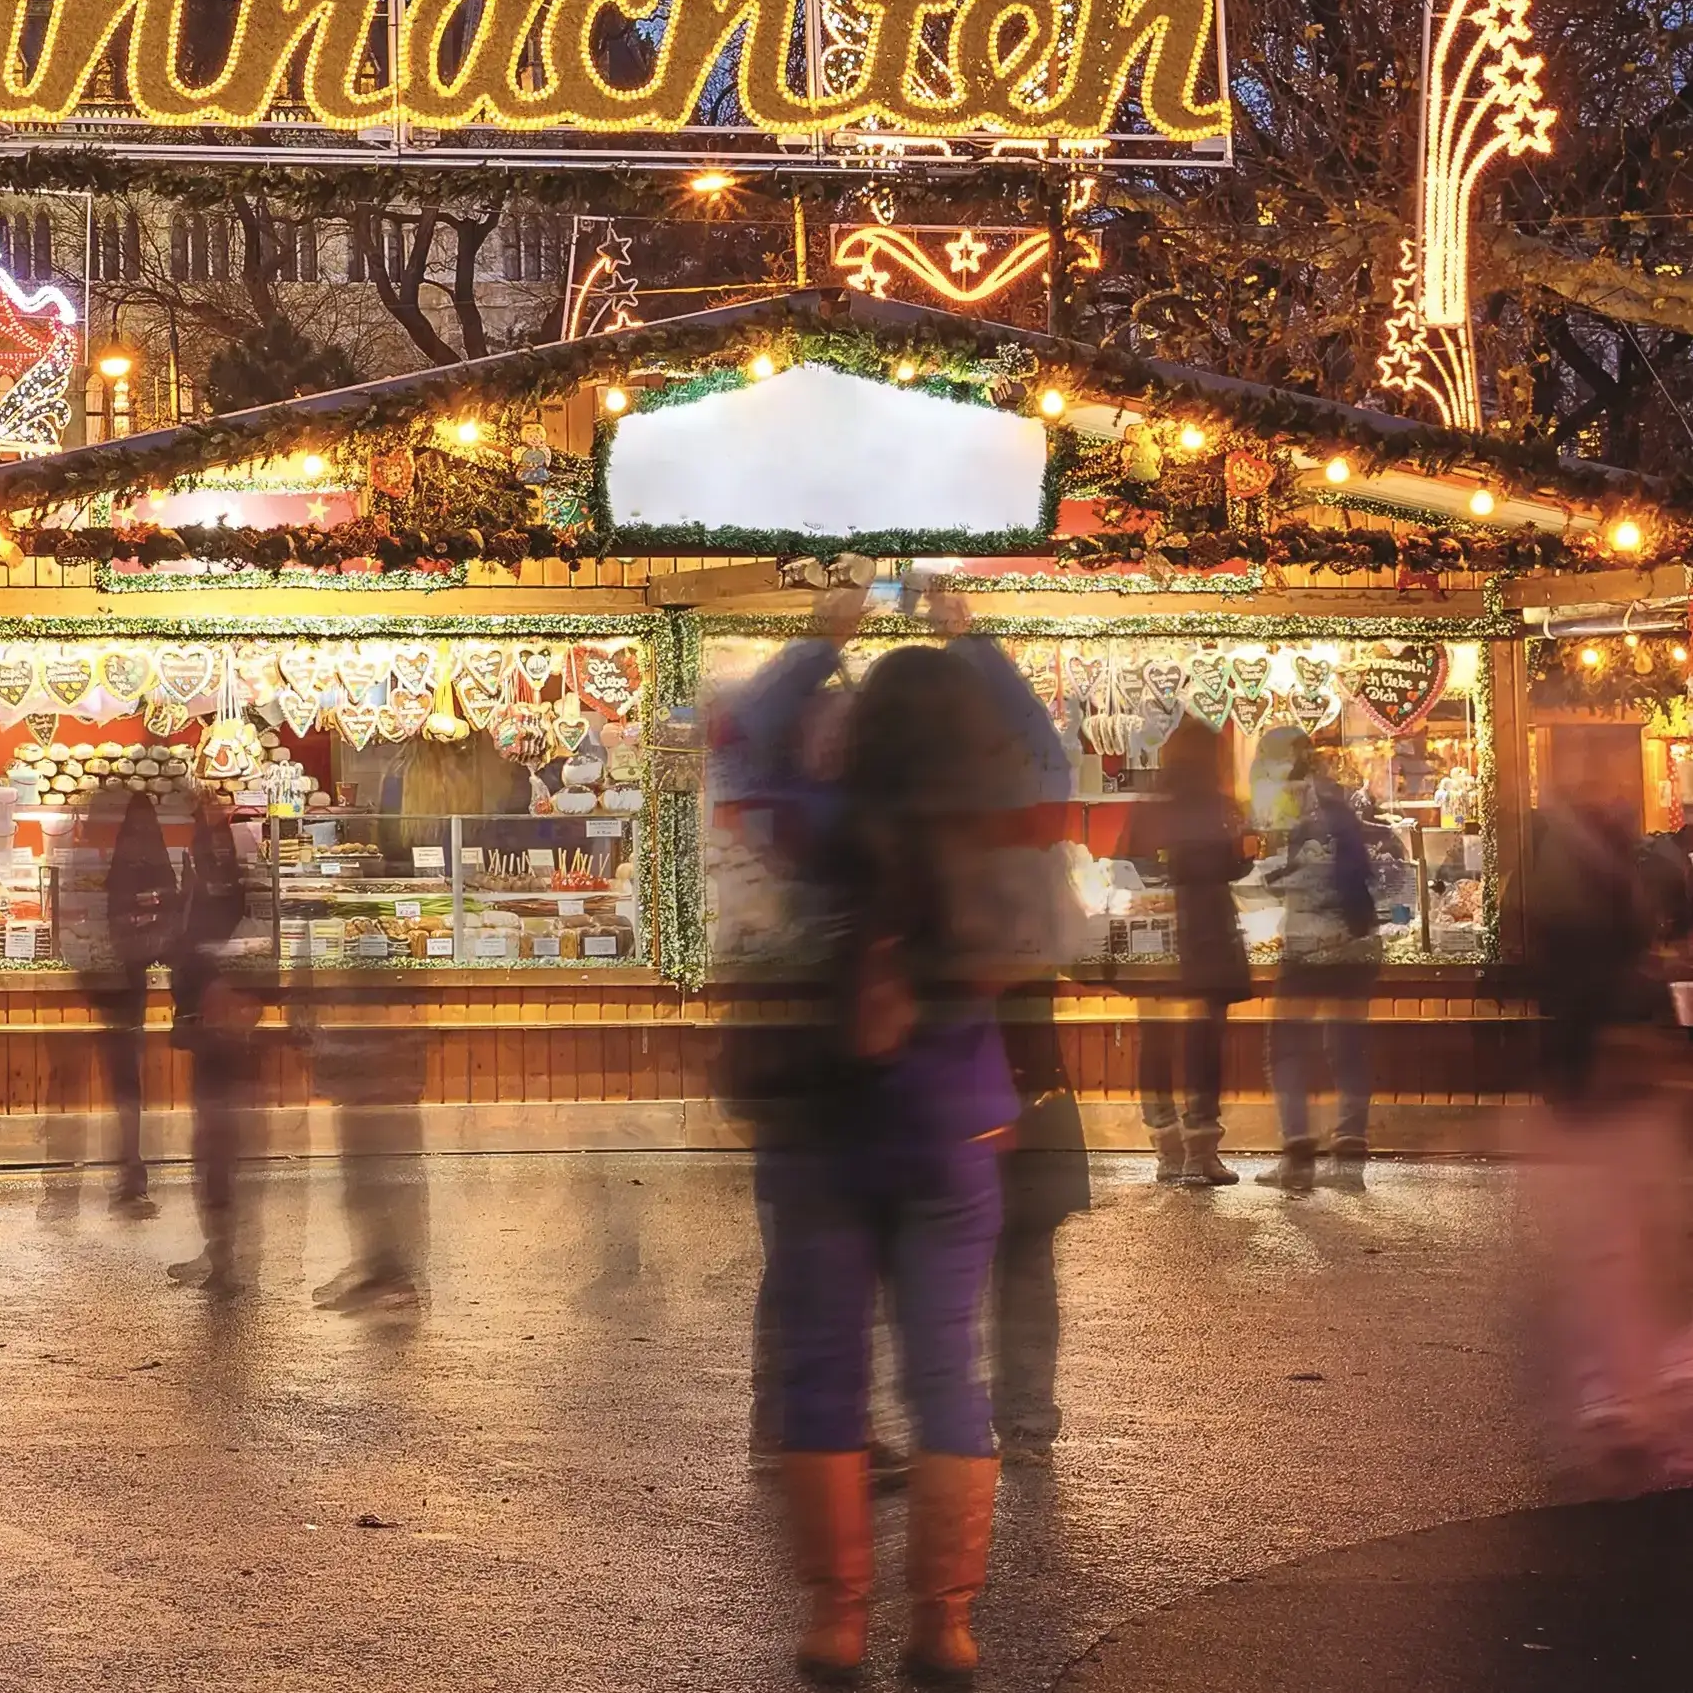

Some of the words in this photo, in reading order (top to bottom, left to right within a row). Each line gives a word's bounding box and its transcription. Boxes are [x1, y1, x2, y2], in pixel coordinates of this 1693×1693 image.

[1365, 671, 1380, 687] ch
[1381, 671, 1414, 690] liebe
[1365, 686, 1399, 703] Dich
